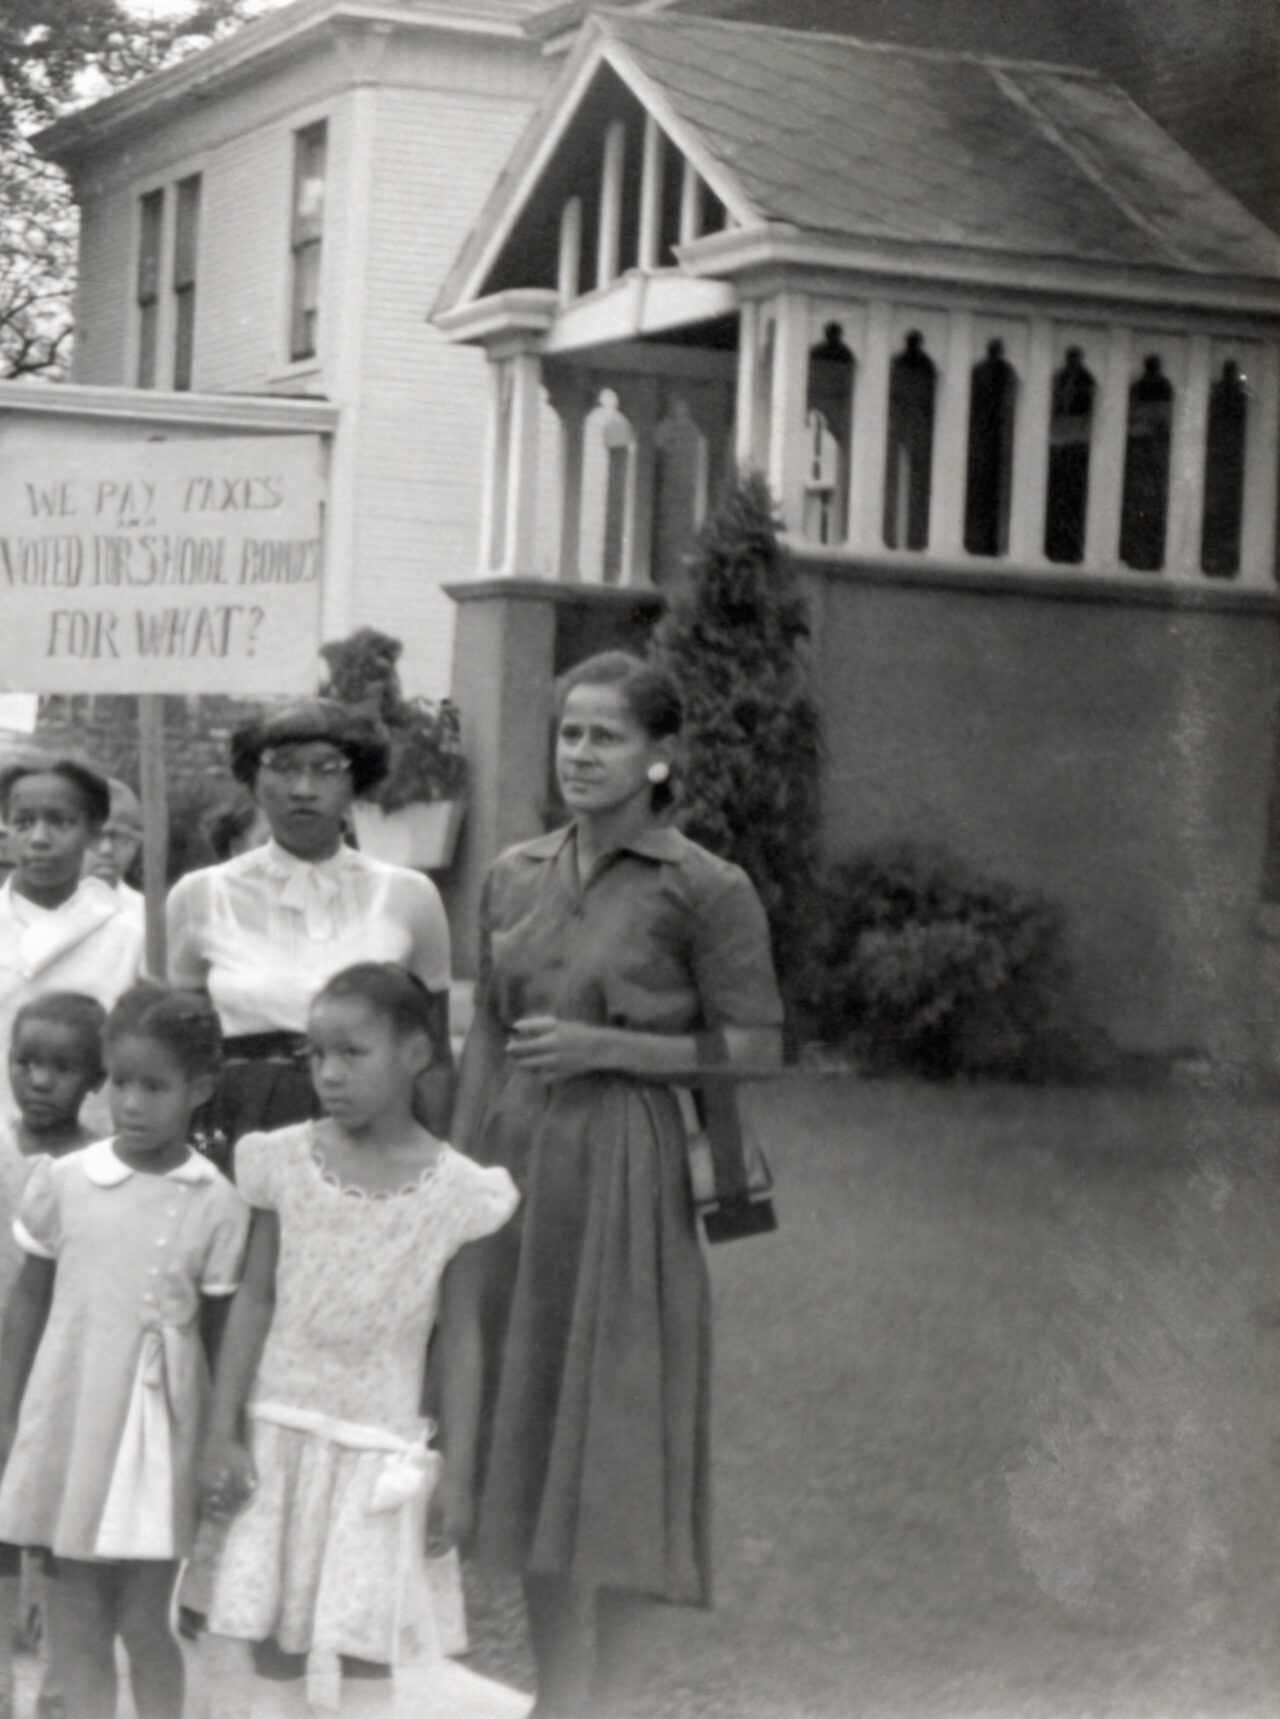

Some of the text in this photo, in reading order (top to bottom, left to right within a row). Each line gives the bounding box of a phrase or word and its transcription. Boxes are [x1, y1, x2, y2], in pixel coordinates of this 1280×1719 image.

[26, 475, 284, 517] WE PAY TAXES
[91, 535, 135, 587] FOR
[46, 604, 265, 660] FOR WHAT?
